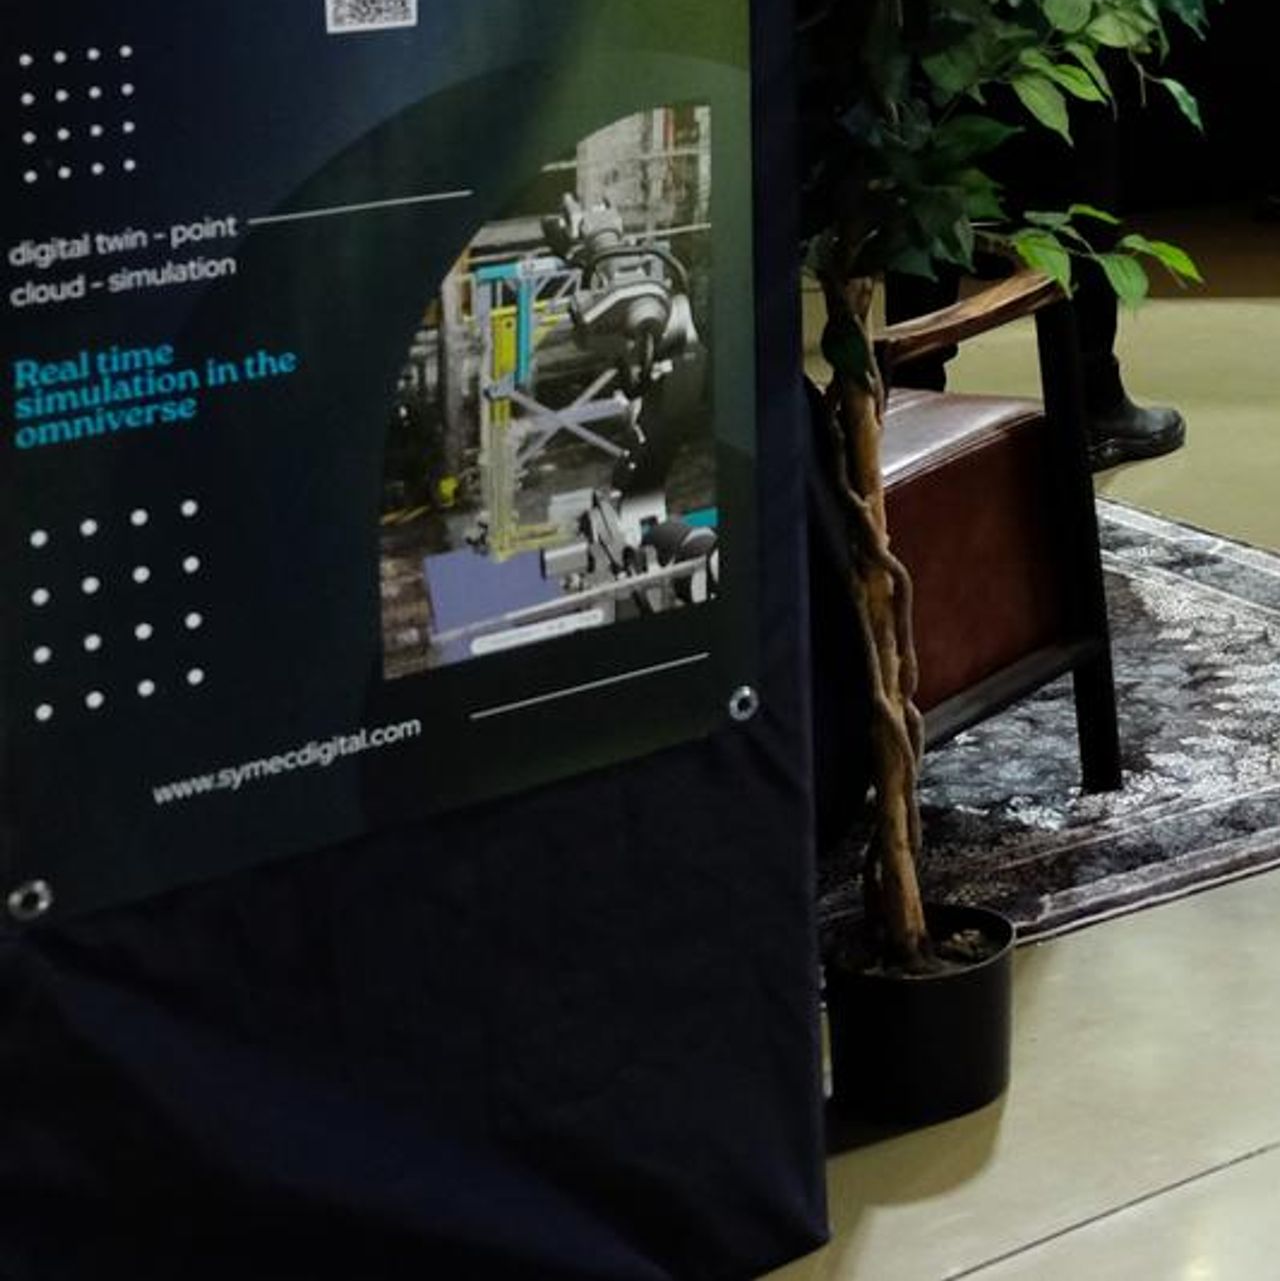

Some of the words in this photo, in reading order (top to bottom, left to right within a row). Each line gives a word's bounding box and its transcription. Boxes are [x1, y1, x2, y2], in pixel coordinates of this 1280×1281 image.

[9, 231, 91, 270] digital
[95, 226, 148, 255] twin
[171, 216, 238, 250] point
[10, 274, 86, 308] cloud
[108, 255, 237, 294] simulation
[14, 351, 89, 390] Real
[96, 343, 175, 373] time
[15, 365, 199, 419] simulation
[206, 358, 240, 387] in
[244, 349, 298, 380] the
[15, 397, 198, 450] omniverse
[153, 718, 421, 806] www.symecdigital.com
